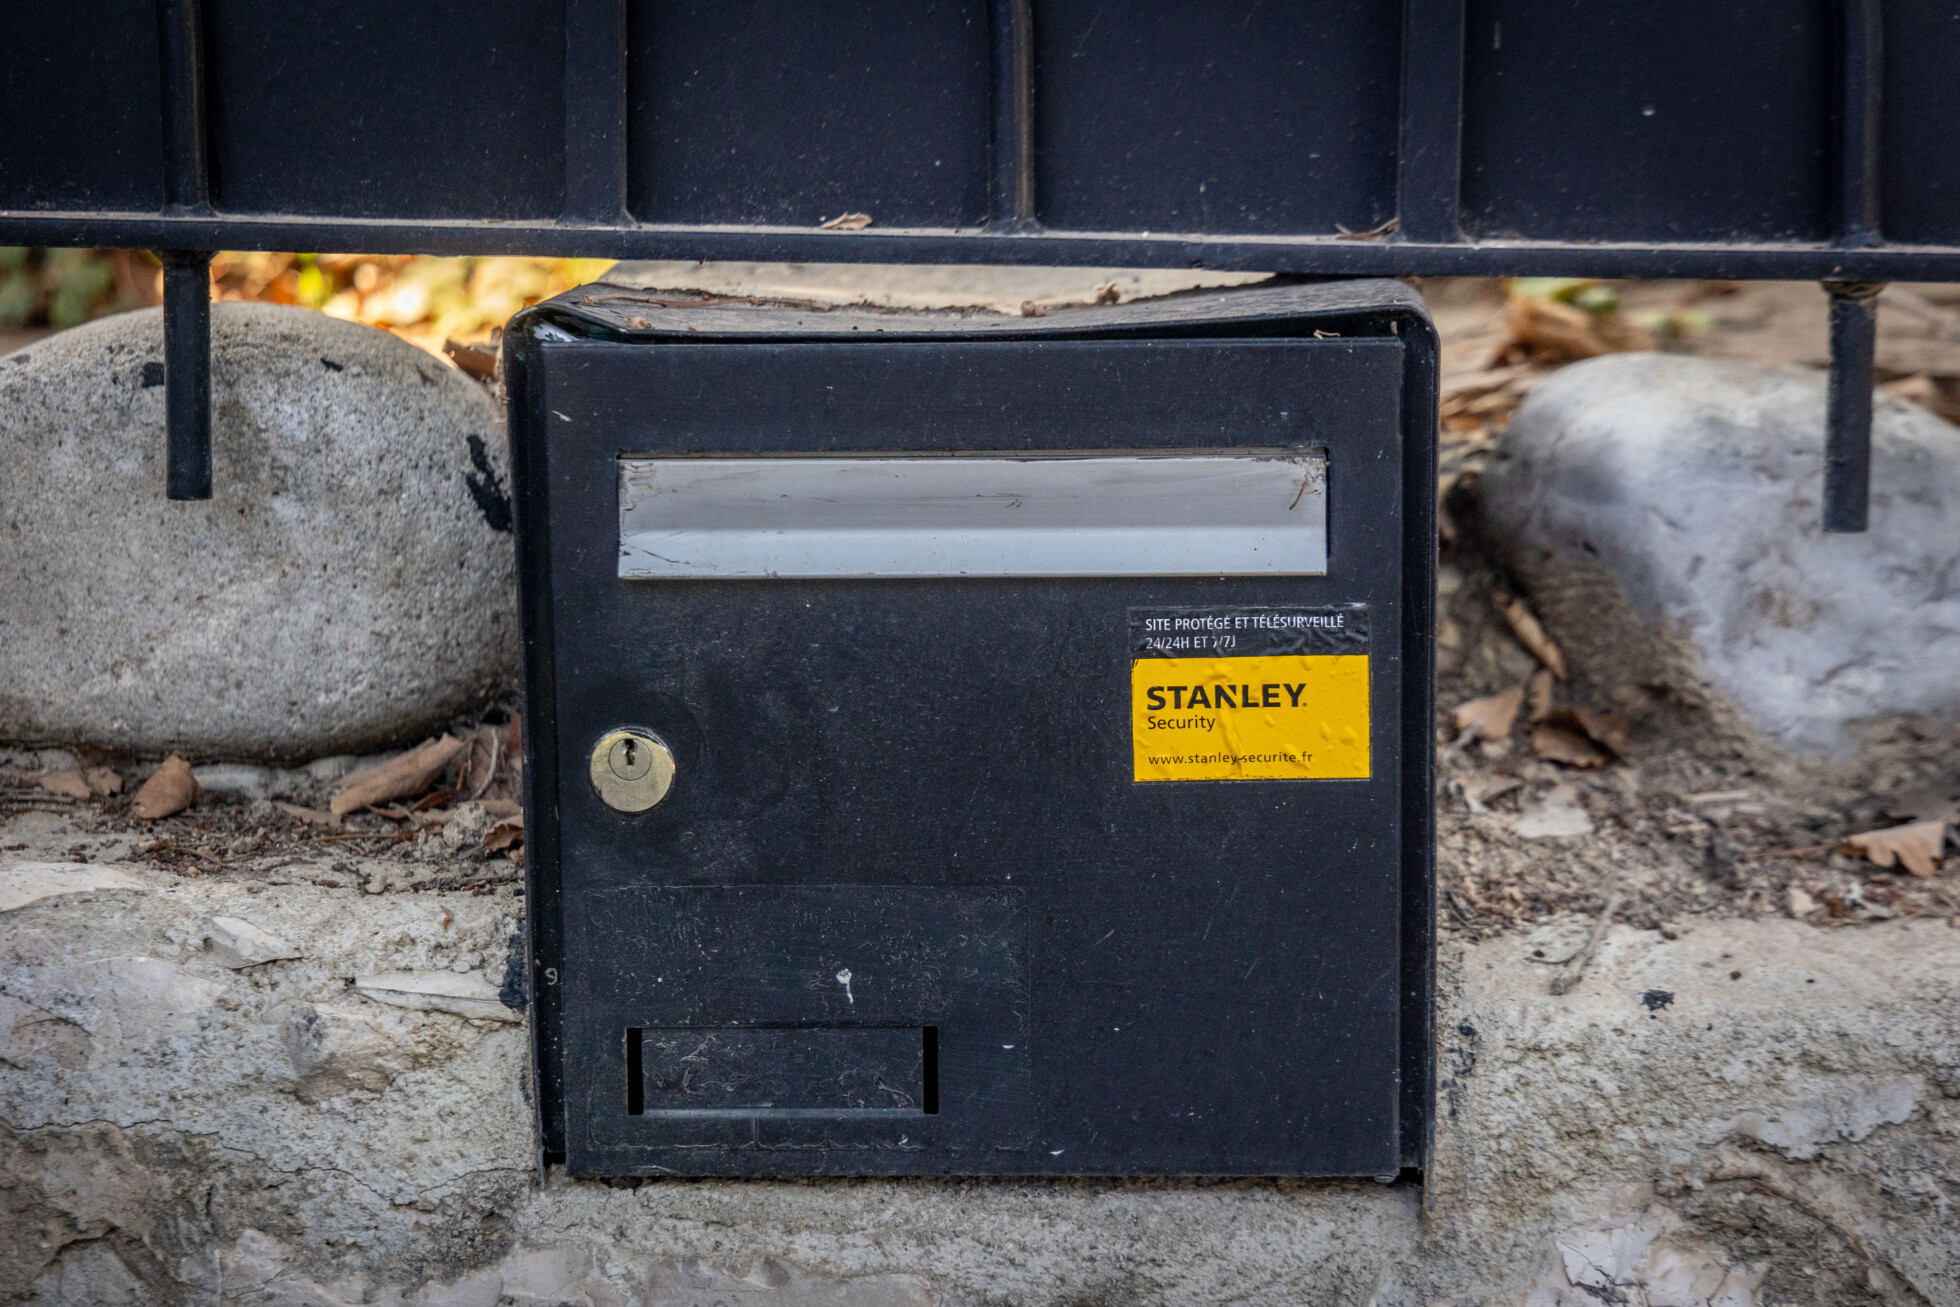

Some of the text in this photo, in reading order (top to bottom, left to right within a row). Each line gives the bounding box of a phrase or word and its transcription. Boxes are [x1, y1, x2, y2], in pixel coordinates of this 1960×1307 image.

[1145, 613, 1344, 631] SITE PROTÉGÉ ET TÉLÉSURVEILLÉ
[1146, 636, 1189, 649] 24/24H
[1194, 636, 1208, 648] ET
[1147, 683, 1306, 710] STANLEY
[1148, 715, 1215, 731] Security
[1148, 751, 1312, 765] www.stanley-securite.fr
